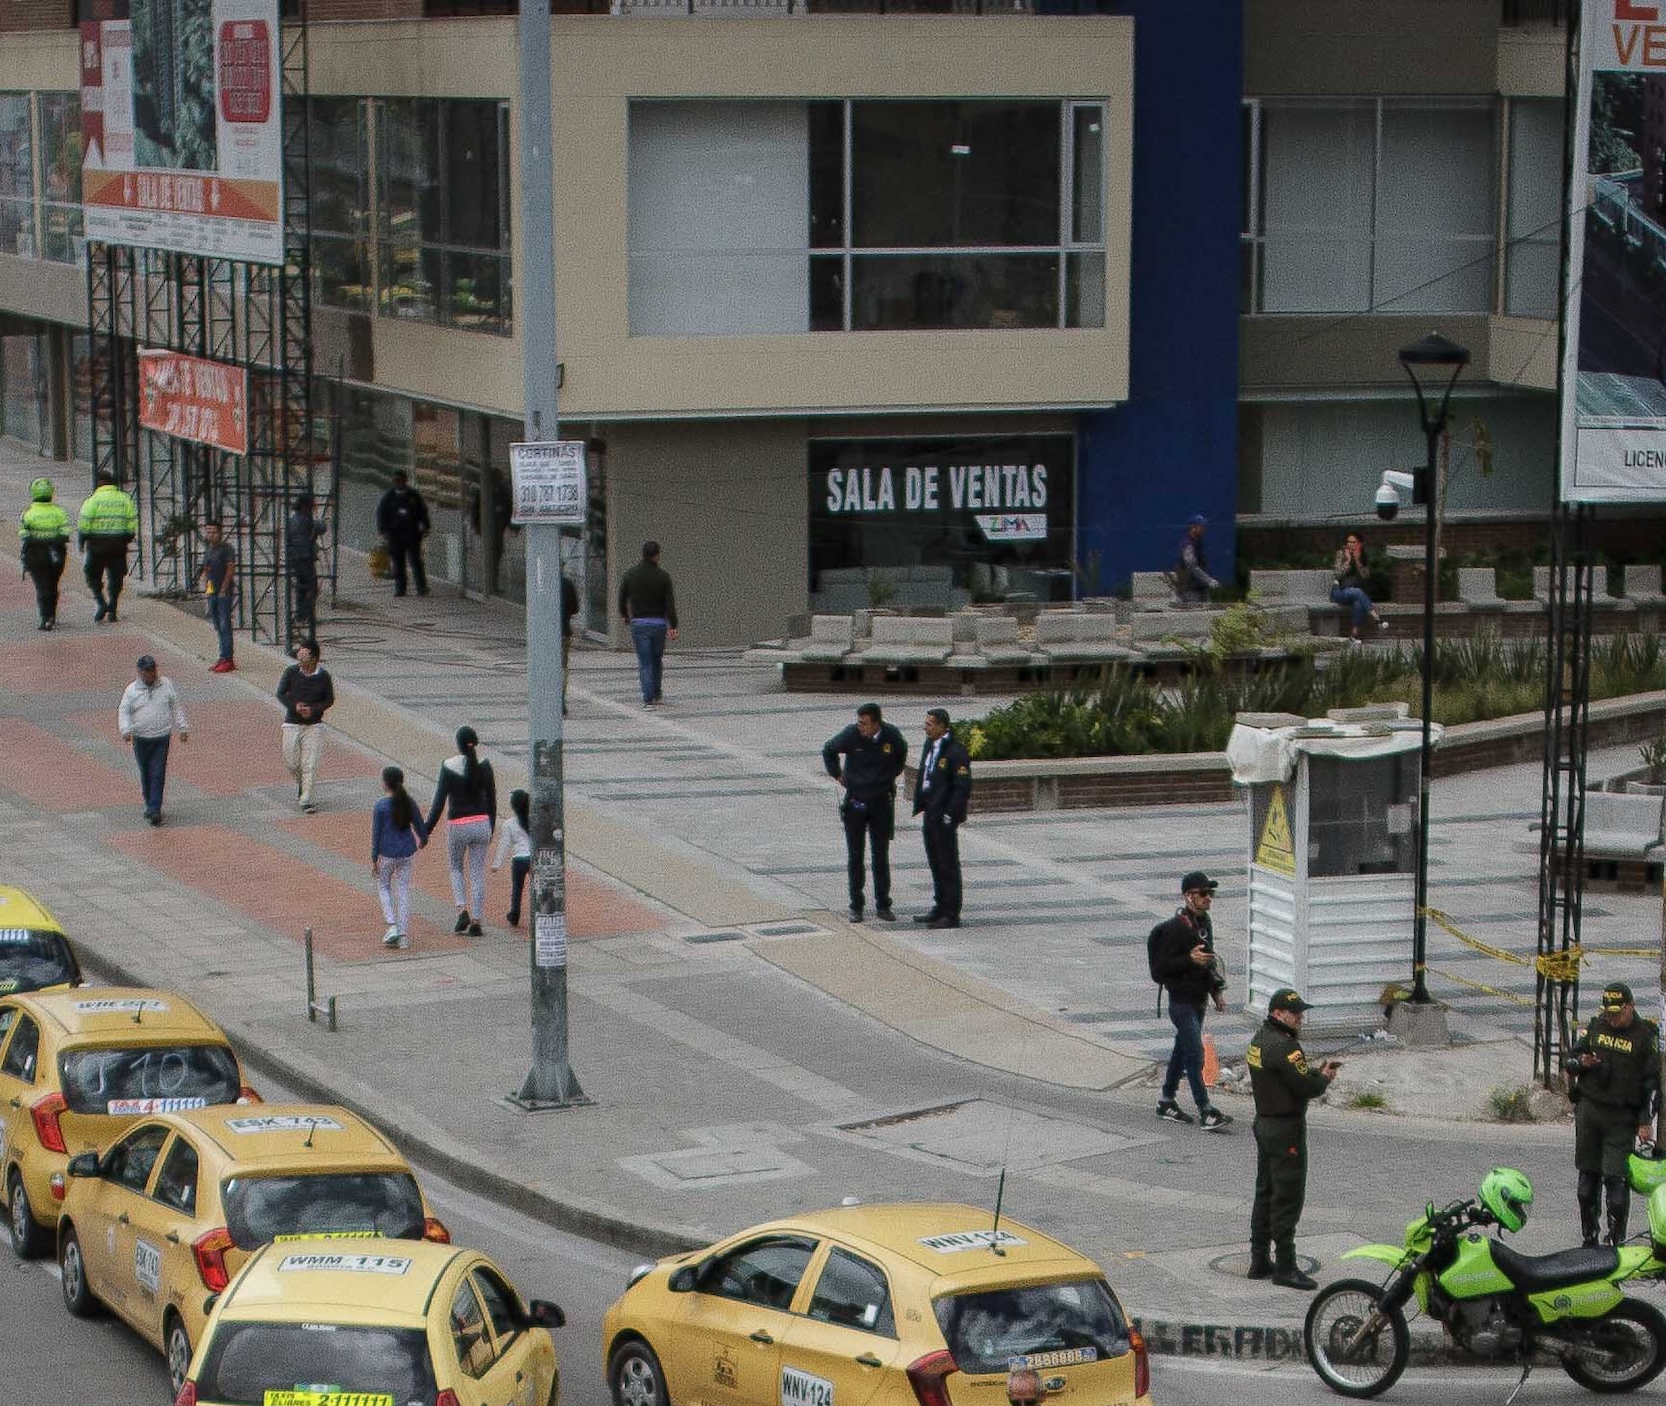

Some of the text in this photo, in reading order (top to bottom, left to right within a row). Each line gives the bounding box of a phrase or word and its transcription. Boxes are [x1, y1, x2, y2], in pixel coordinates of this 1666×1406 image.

[827, 464, 1048, 512] SALA DE VENTAS
[1597, 1033, 1633, 1054] POLICIA
[128, 1051, 189, 1097] 10
[289, 1256, 404, 1268] WMM 115
[782, 1371, 809, 1402] WNV
